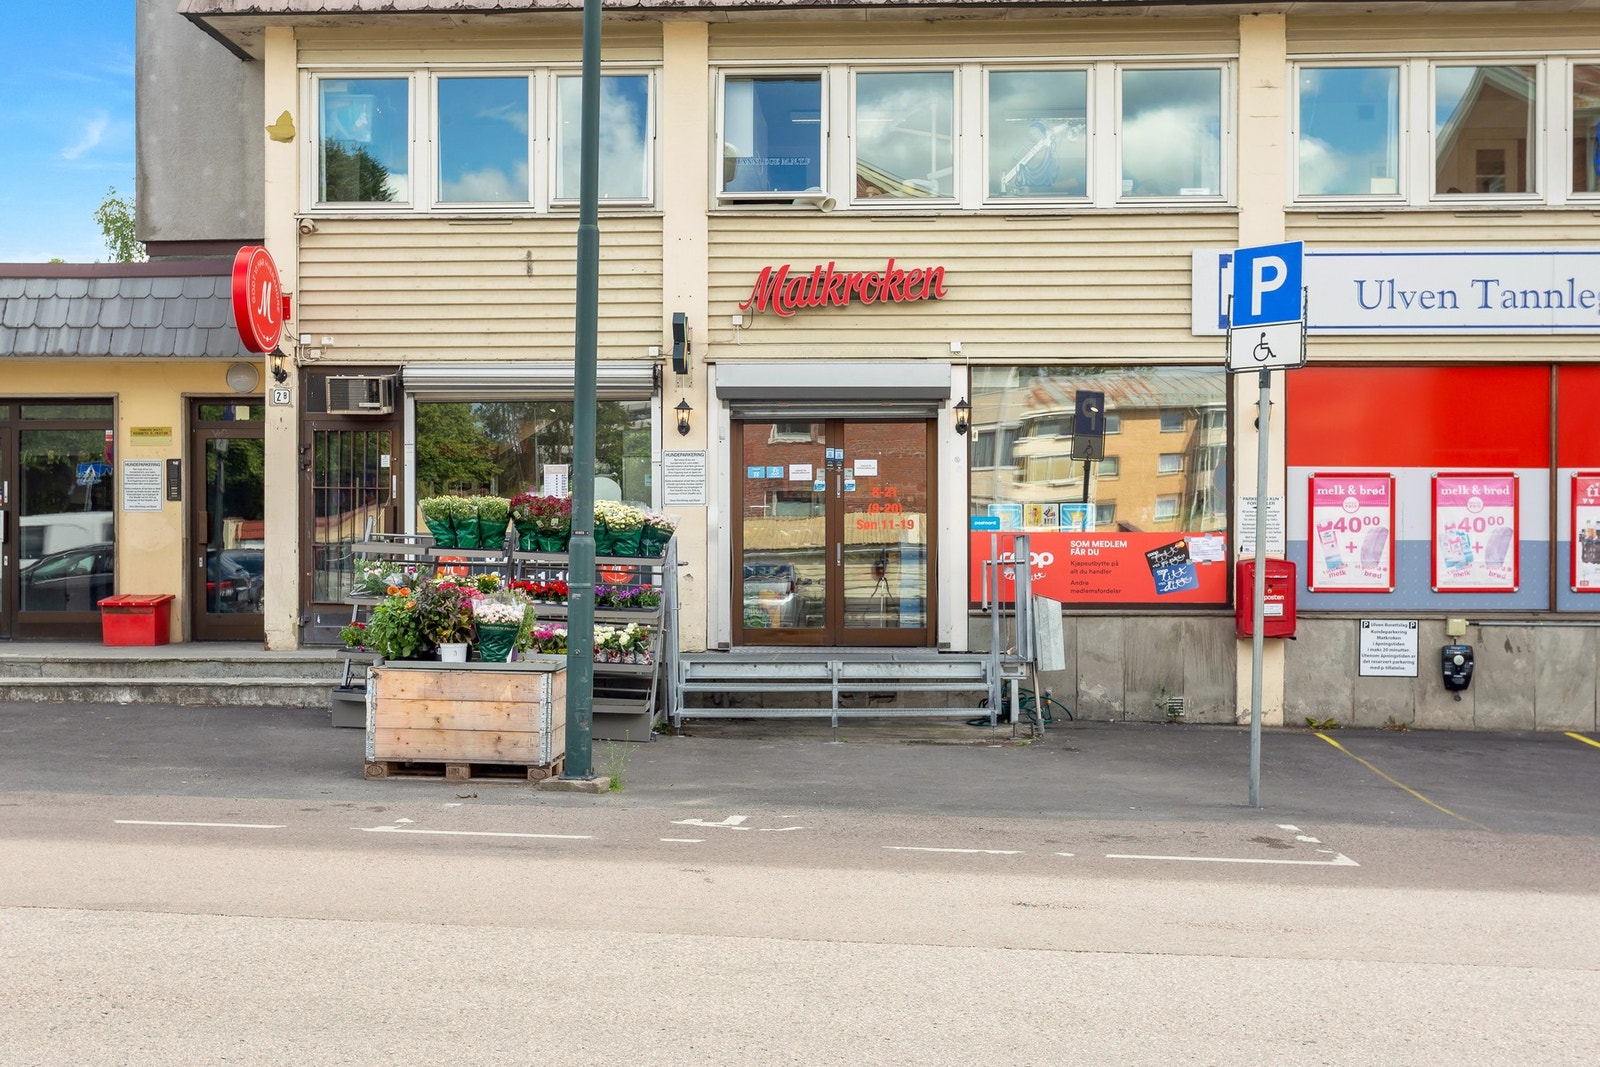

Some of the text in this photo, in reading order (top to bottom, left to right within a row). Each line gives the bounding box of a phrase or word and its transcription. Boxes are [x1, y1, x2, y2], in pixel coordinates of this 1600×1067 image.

[737, 258, 949, 318] Matkroken
[1250, 255, 1288, 316] P
[1354, 278, 1458, 310] Ulven
[257, 280, 274, 324] M
[871, 486, 897, 498] 8-21
[1316, 484, 1386, 496] melk & brød
[1440, 484, 1511, 496] melk & brød
[867, 502, 903, 517] (9-20)
[856, 518, 915, 531] Søn 11-19
[1070, 540, 1128, 548] SOM MEDLEM
[1070, 547, 1100, 556] FÅR DU
[999, 552, 1054, 568] cop
[1070, 559, 1119, 568] Kjøpeutbytte på
[1264, 594, 1285, 602] posten
